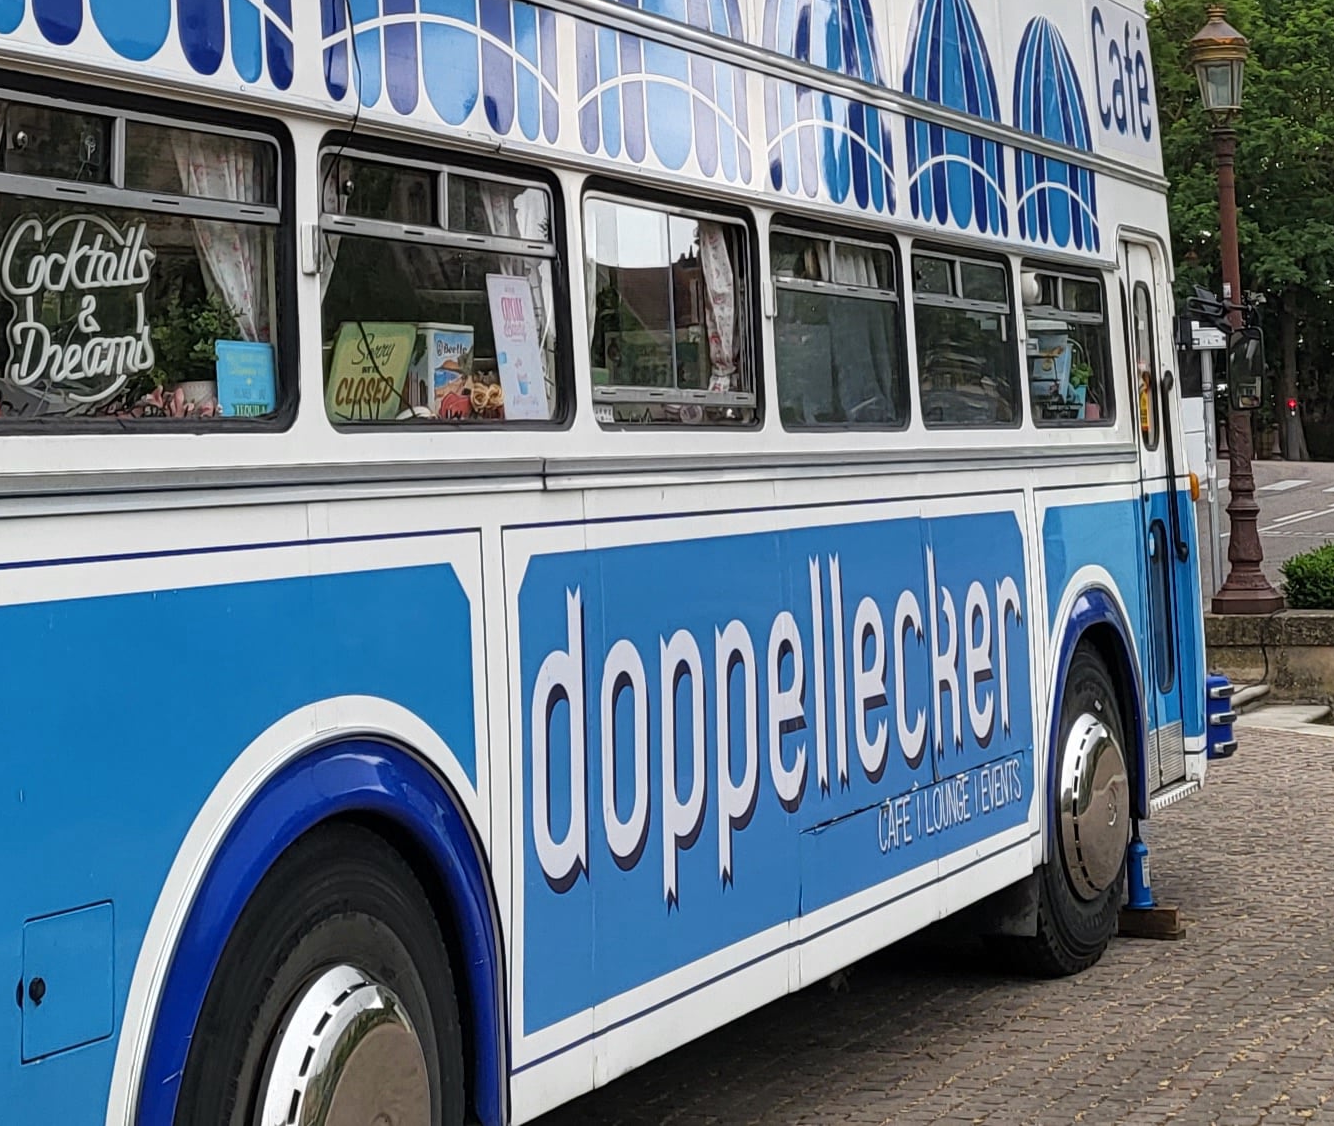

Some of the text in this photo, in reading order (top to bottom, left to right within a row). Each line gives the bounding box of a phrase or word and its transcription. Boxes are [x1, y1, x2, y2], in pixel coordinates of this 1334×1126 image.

[1091, 6, 1152, 142] Café
[2, 219, 156, 295] Cocktails
[78, 295, 101, 332] &
[11, 322, 154, 385] Dreams
[352, 333, 395, 366] Sorry
[335, 376, 394, 406] CLOSED
[531, 544, 1023, 915] doppellecker
[924, 771, 971, 835] LOUNGE
[981, 758, 1022, 812] EVENTS
